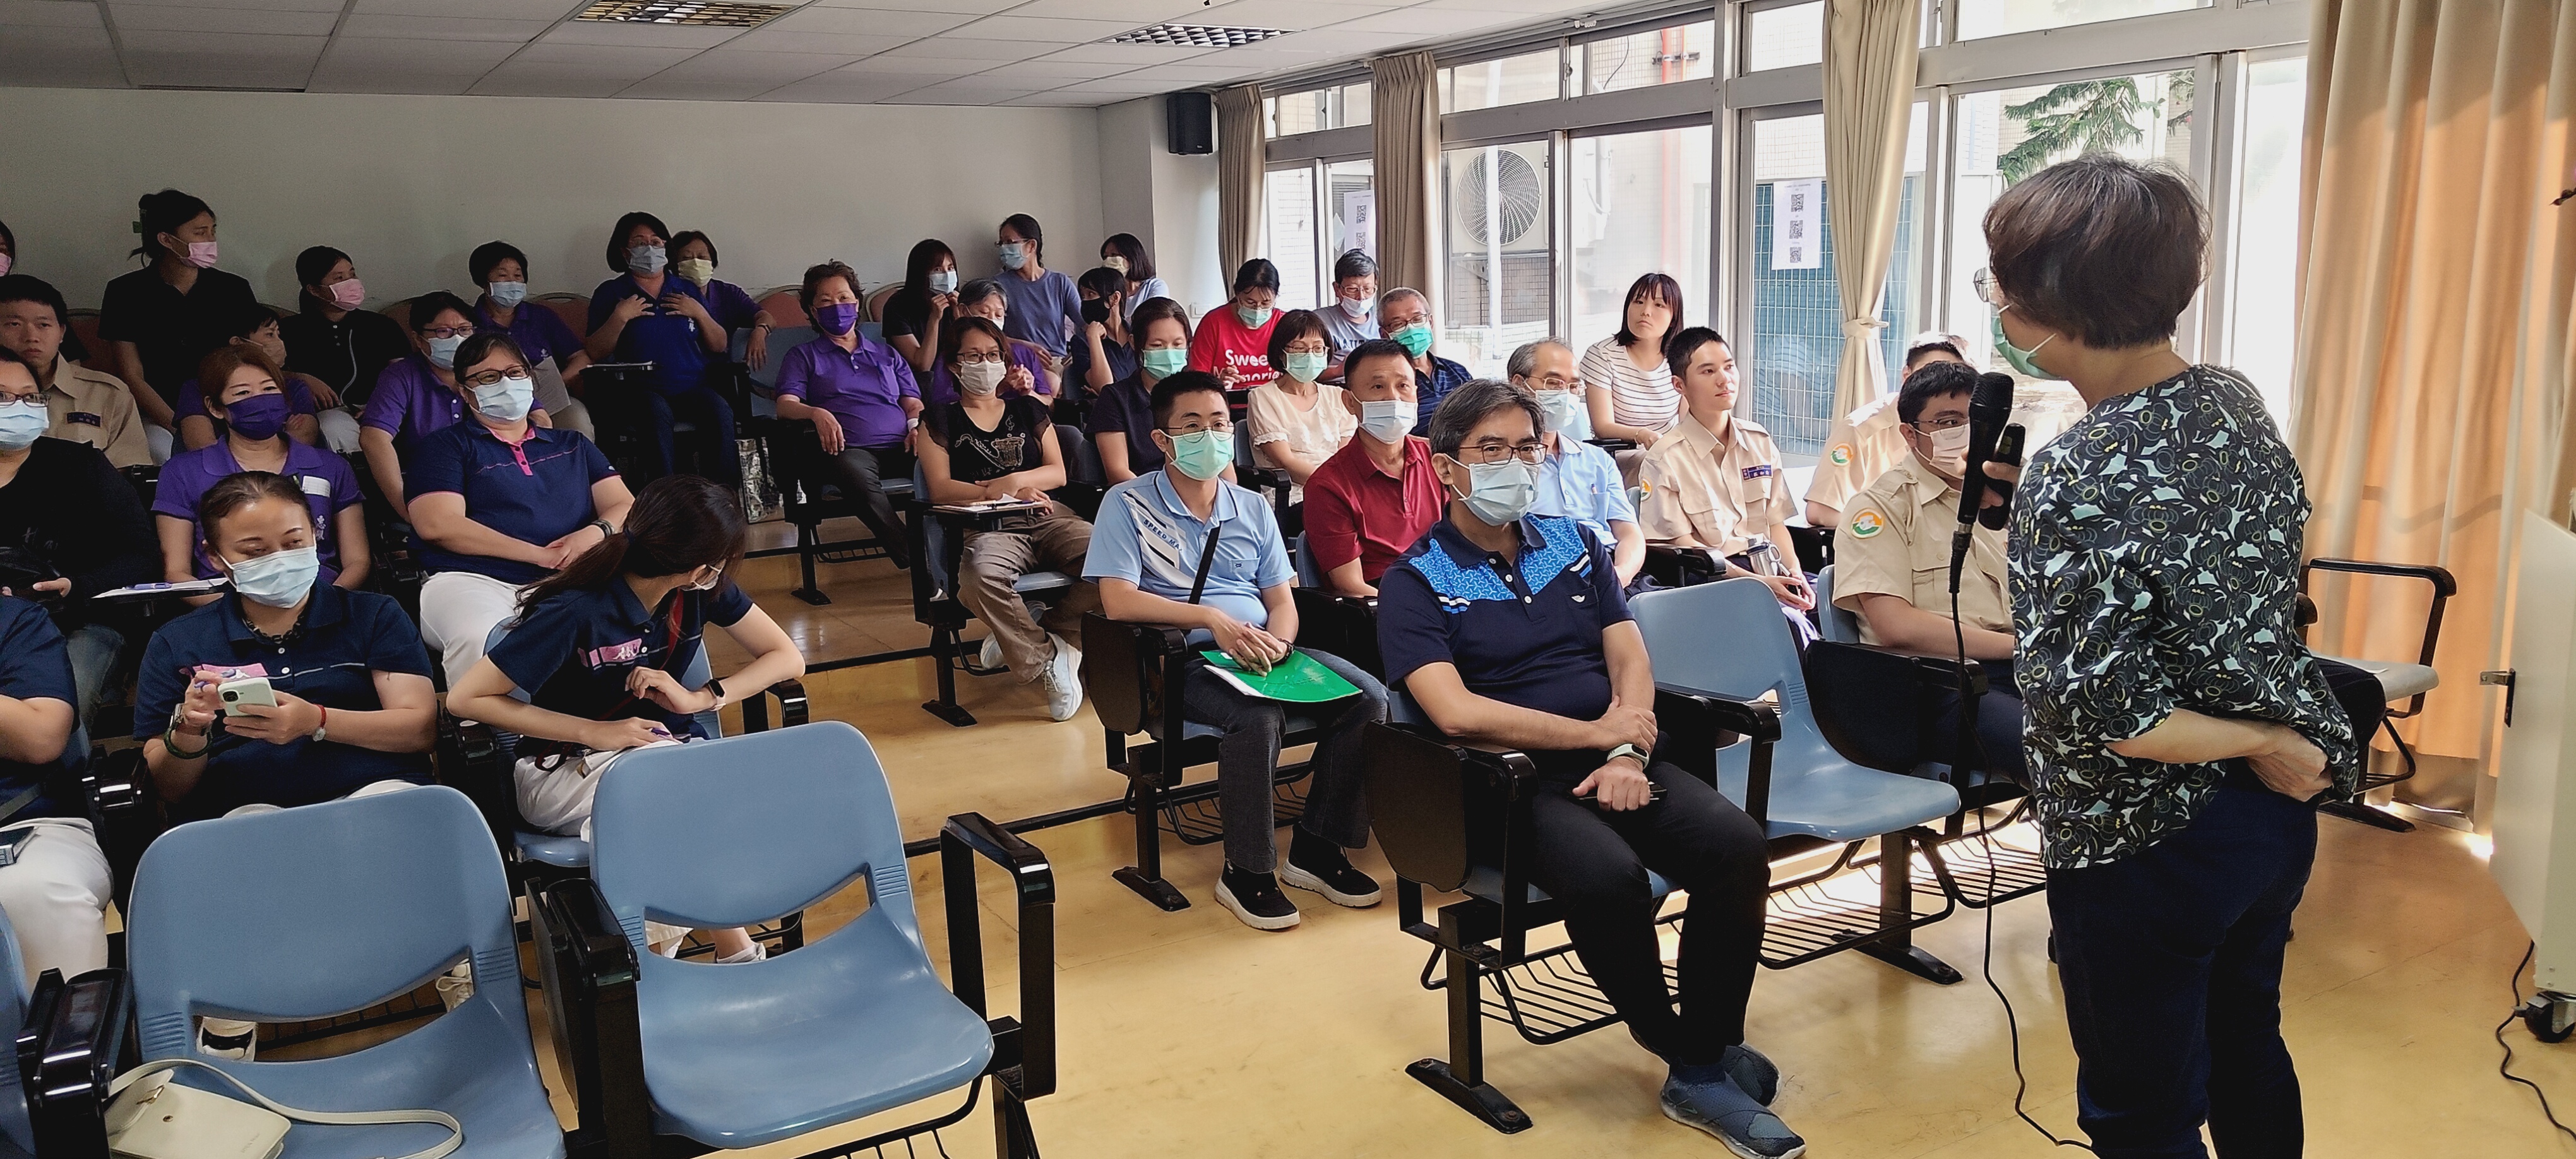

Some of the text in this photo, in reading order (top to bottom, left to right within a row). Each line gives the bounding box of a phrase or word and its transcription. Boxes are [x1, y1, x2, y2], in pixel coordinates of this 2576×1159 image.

[1333, 335, 1364, 352] NAUT
[1225, 349, 1268, 366] Swee
[1143, 519, 1167, 539] SPEED
